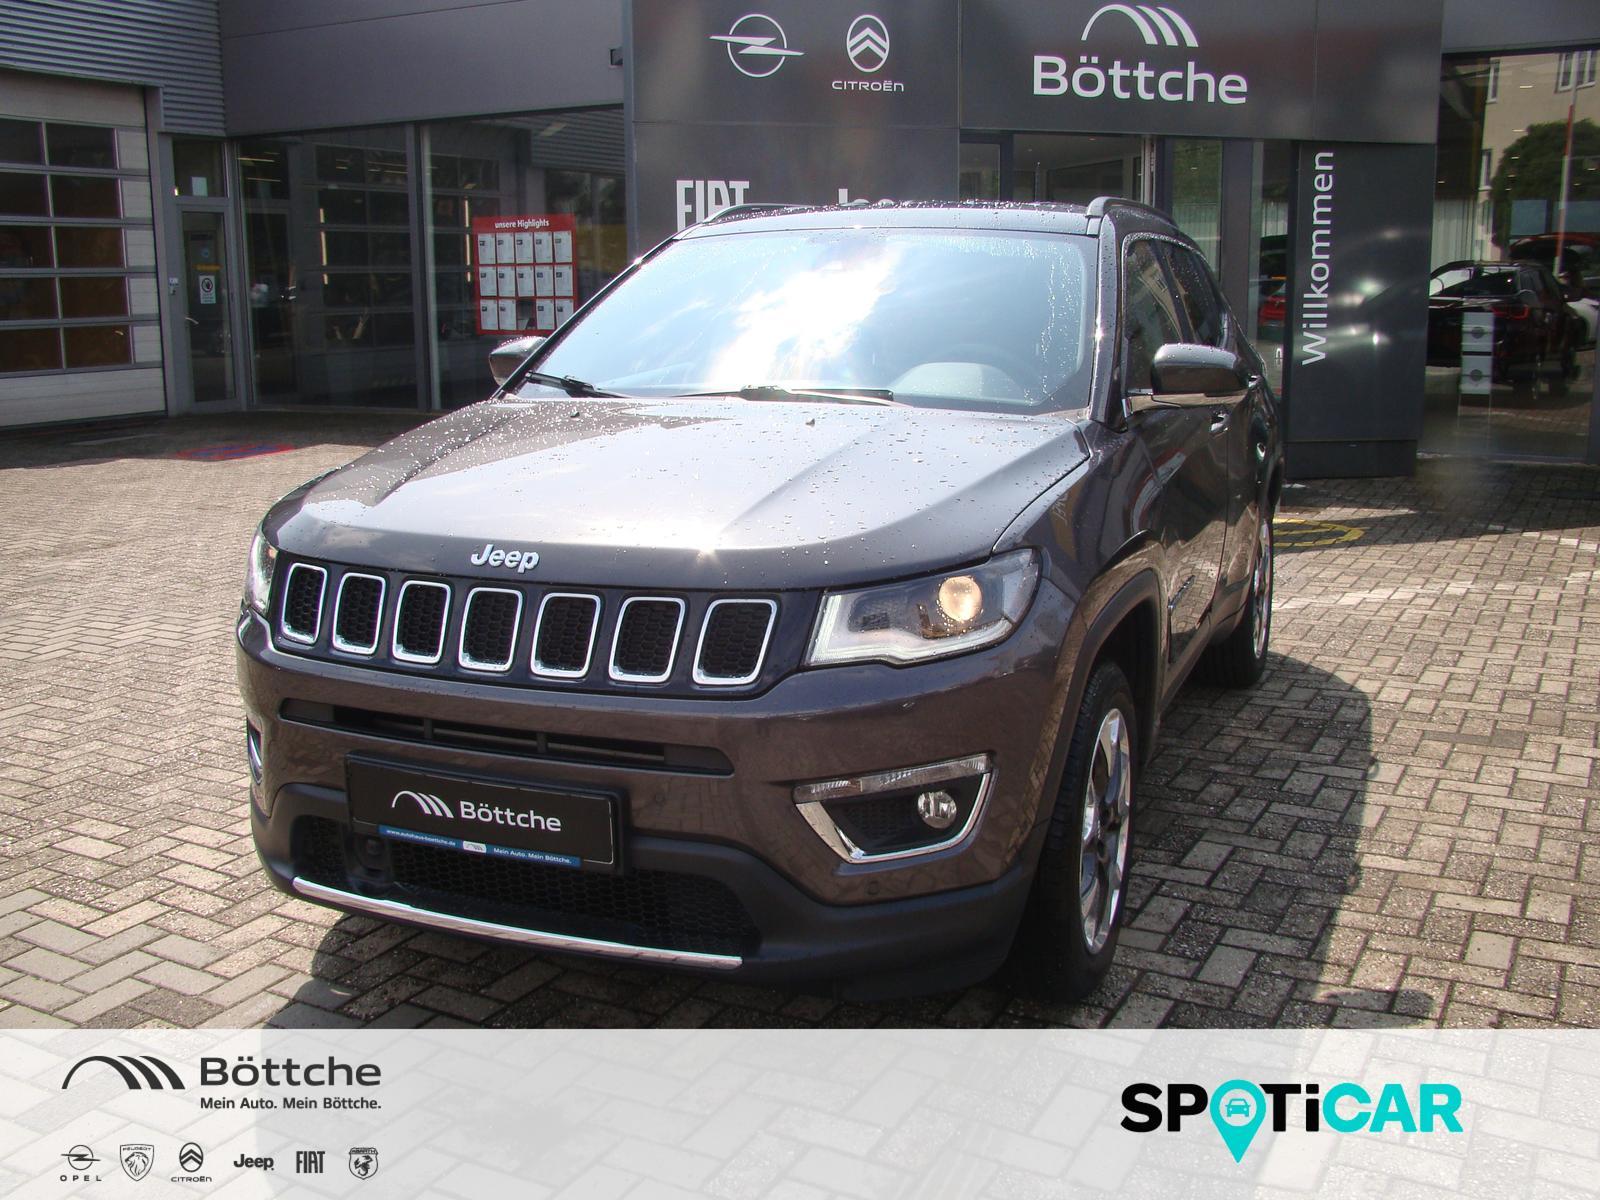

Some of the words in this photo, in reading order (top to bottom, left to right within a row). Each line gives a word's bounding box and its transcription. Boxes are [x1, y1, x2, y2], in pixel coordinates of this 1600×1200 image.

[831, 80, 905, 93] CITROËN
[1033, 54, 1248, 105] Böttche
[495, 221, 516, 229] unsere
[517, 219, 549, 229] Highlights
[1301, 151, 1335, 366] Willkommen
[470, 543, 540, 574] Jeep
[459, 800, 563, 832] Böttche
[493, 847, 509, 856] Mein
[528, 852, 544, 861] Mein
